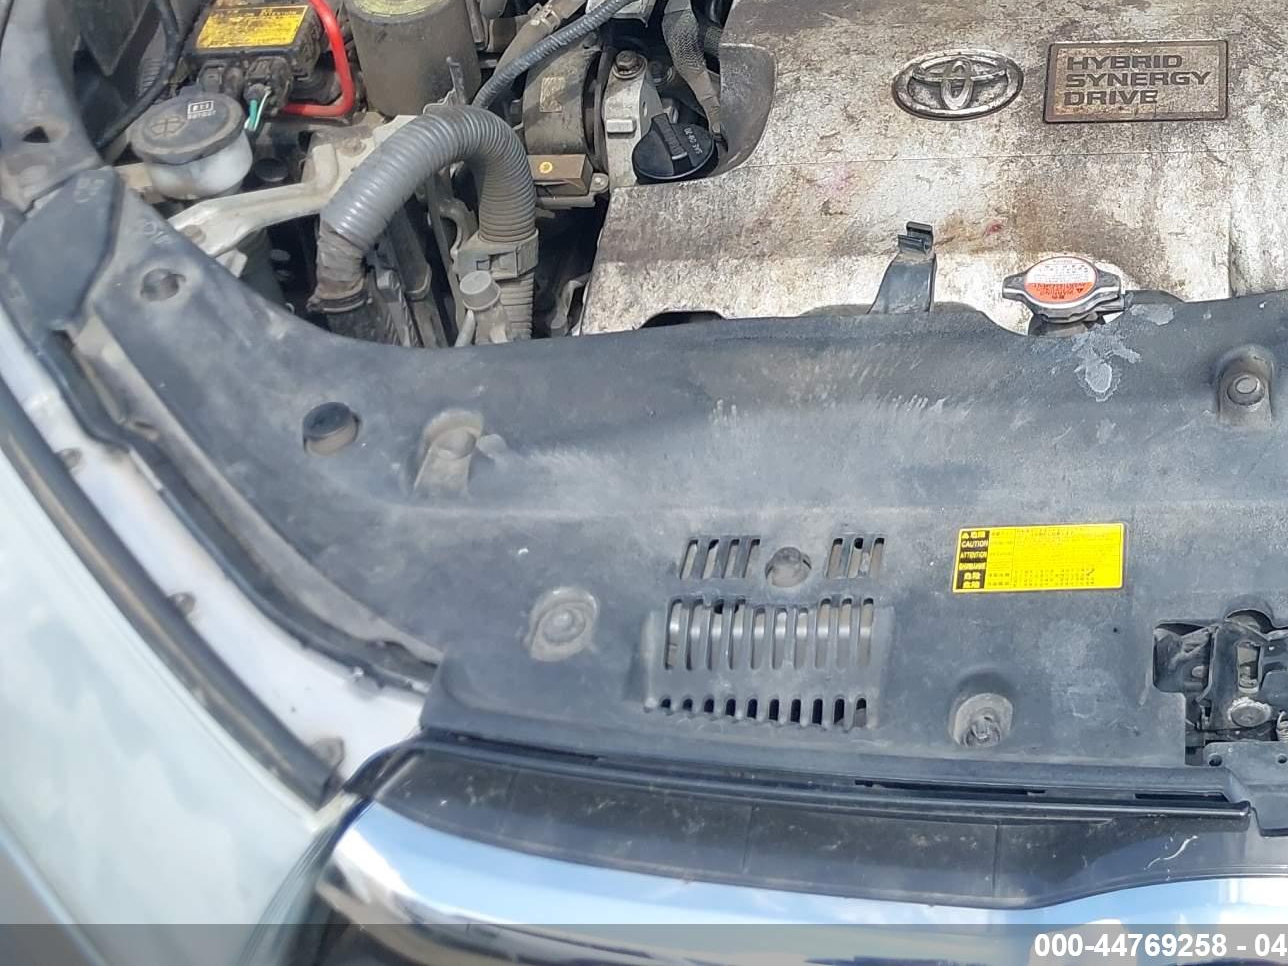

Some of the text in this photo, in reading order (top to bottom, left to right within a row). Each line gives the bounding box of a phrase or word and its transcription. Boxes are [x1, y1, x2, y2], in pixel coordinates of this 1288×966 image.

[1067, 55, 1182, 70] HYBRID
[1065, 71, 1211, 87] SYNERGY
[1063, 90, 1158, 105] DRIVE
[961, 540, 989, 548] CAUTION
[960, 551, 987, 559] ATTENTION
